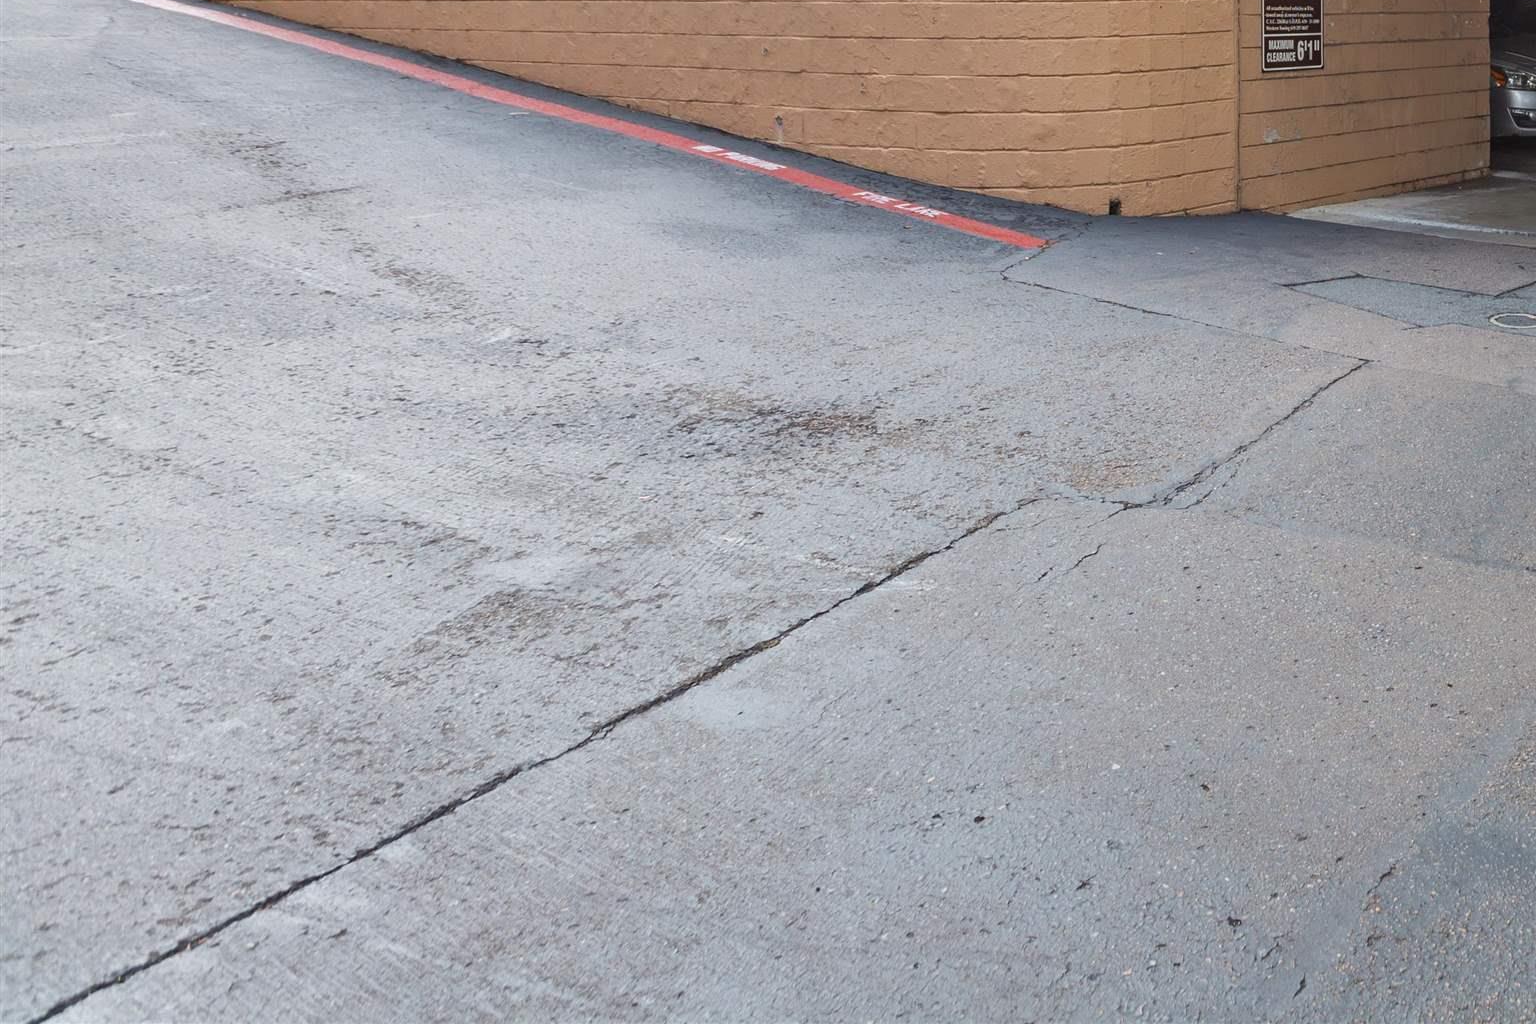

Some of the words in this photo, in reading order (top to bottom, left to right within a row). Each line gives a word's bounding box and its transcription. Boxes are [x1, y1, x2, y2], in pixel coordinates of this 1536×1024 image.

[1268, 39, 1295, 51] MAXIMUM
[1297, 39, 1320, 62] 6'1"
[1266, 51, 1296, 63] CLEARANCE
